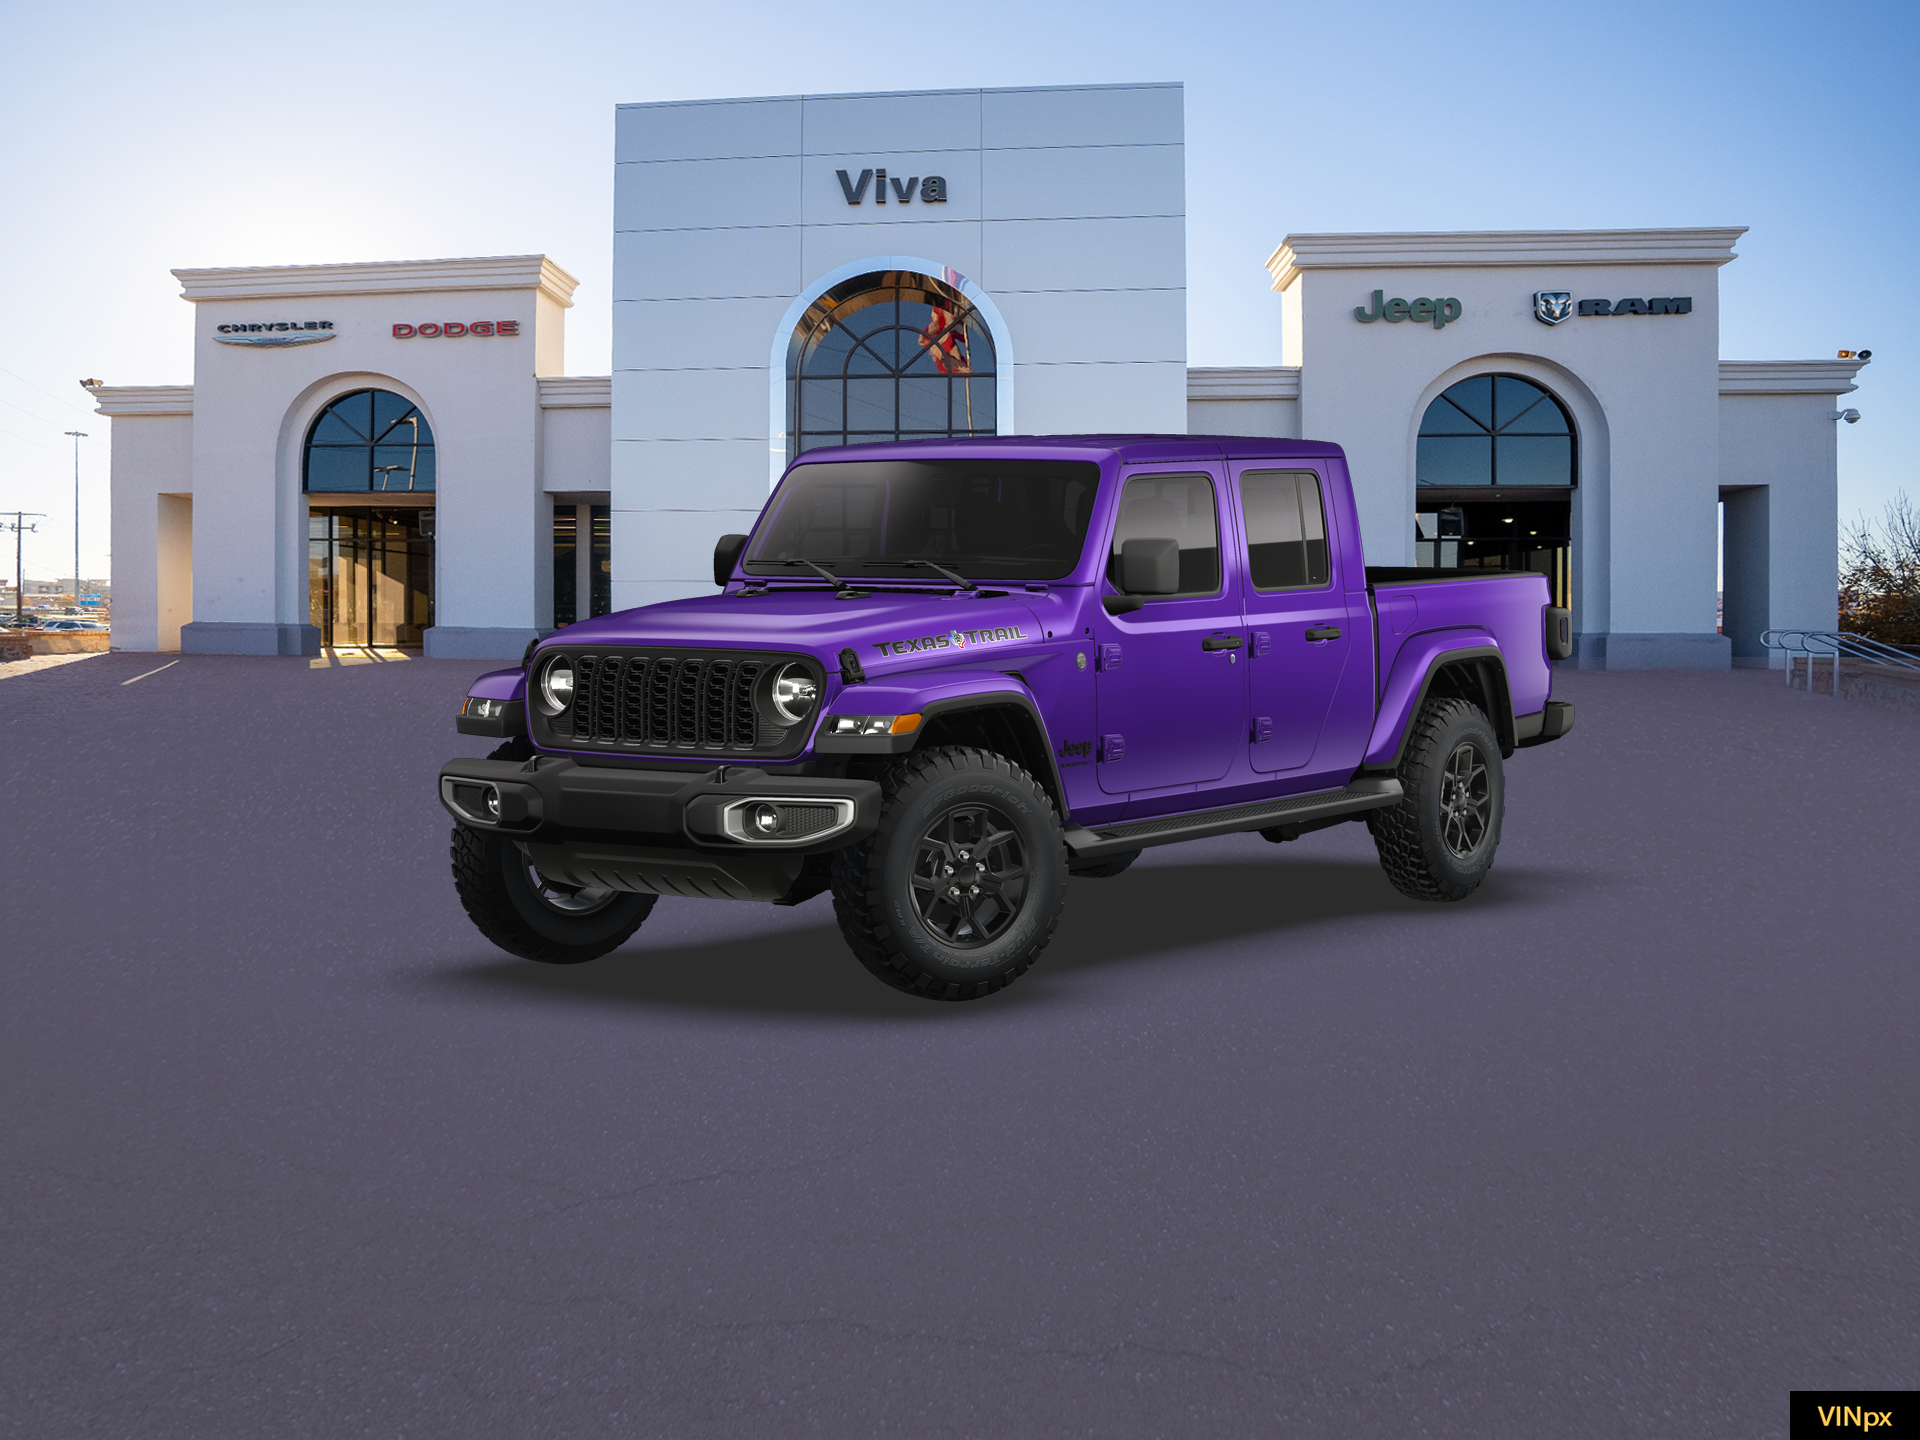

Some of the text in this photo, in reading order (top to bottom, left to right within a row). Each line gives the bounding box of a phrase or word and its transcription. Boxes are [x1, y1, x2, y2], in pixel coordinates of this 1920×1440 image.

[835, 168, 947, 205] Viva
[1354, 289, 1462, 329] Jeep
[1578, 297, 1692, 317] RAM
[217, 321, 334, 334] CHRYSLER
[392, 320, 520, 339] DODGE
[871, 626, 1028, 658] TEXAS TRAIL
[1059, 739, 1092, 758] Jeep
